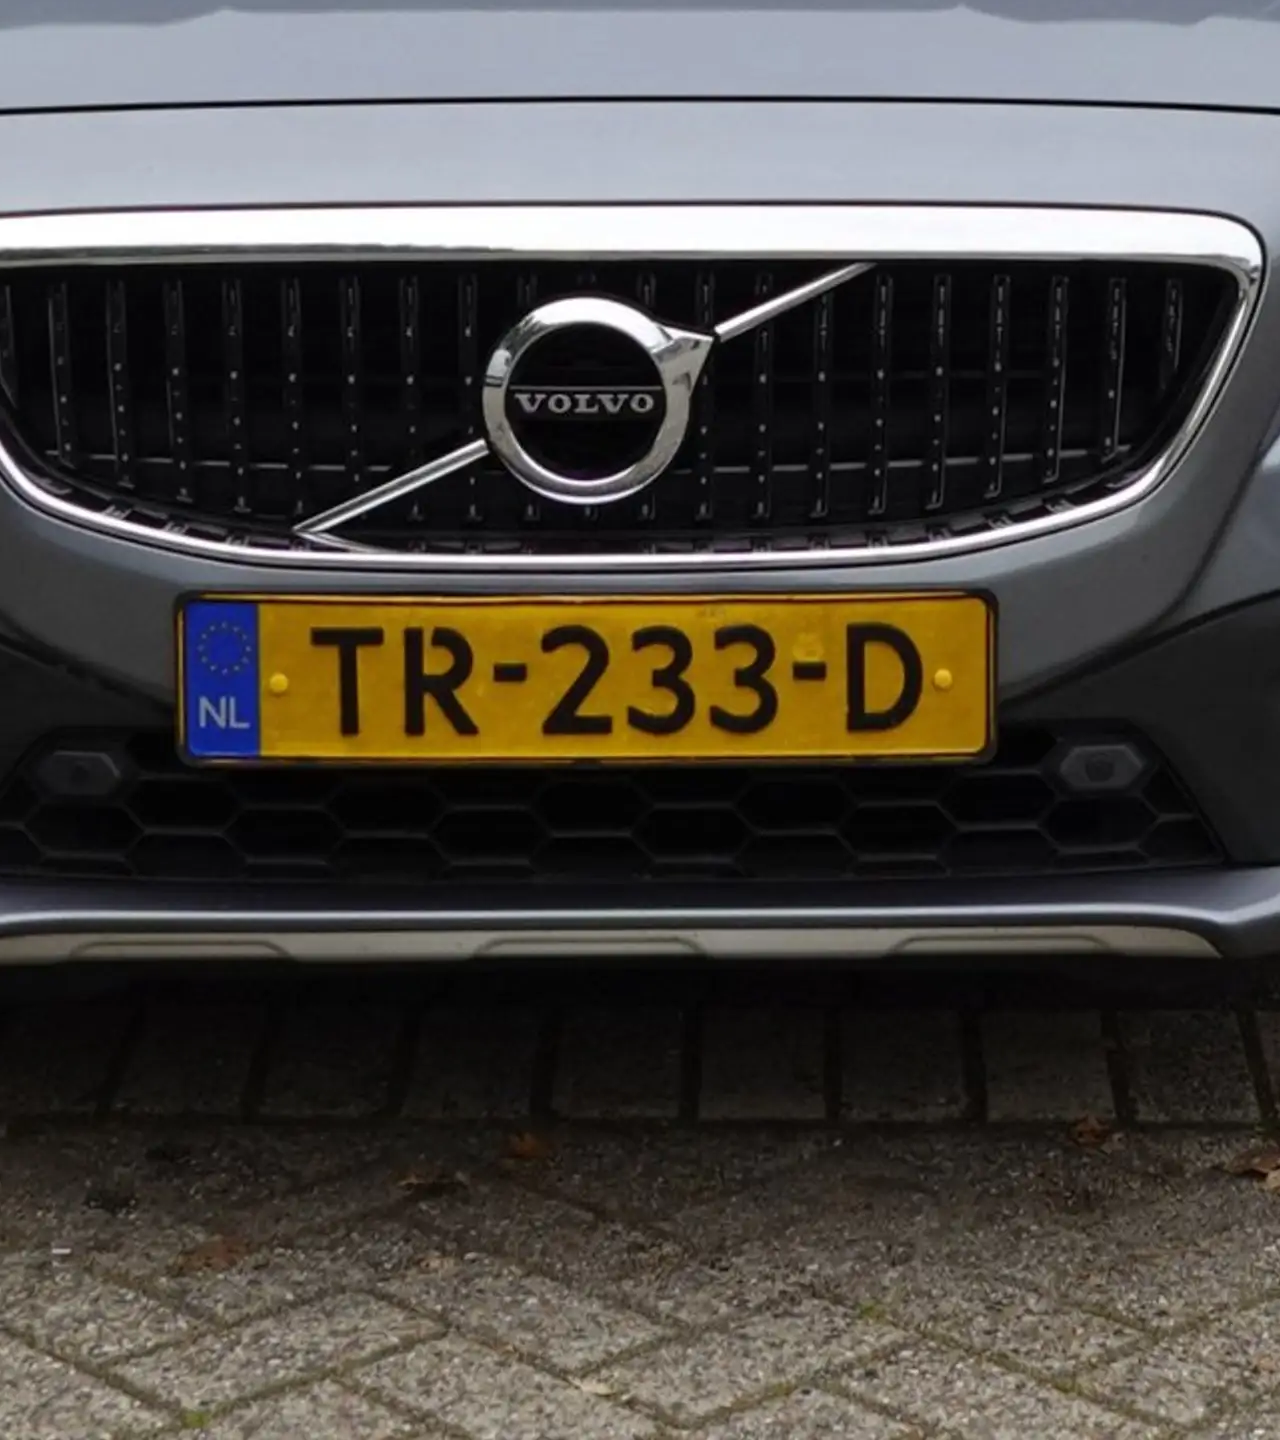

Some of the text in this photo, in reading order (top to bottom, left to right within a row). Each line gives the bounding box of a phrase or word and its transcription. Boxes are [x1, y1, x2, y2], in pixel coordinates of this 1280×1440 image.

[513, 393, 655, 414] VOLVO
[310, 623, 924, 736] TR-233-D
[199, 696, 250, 728] NL
